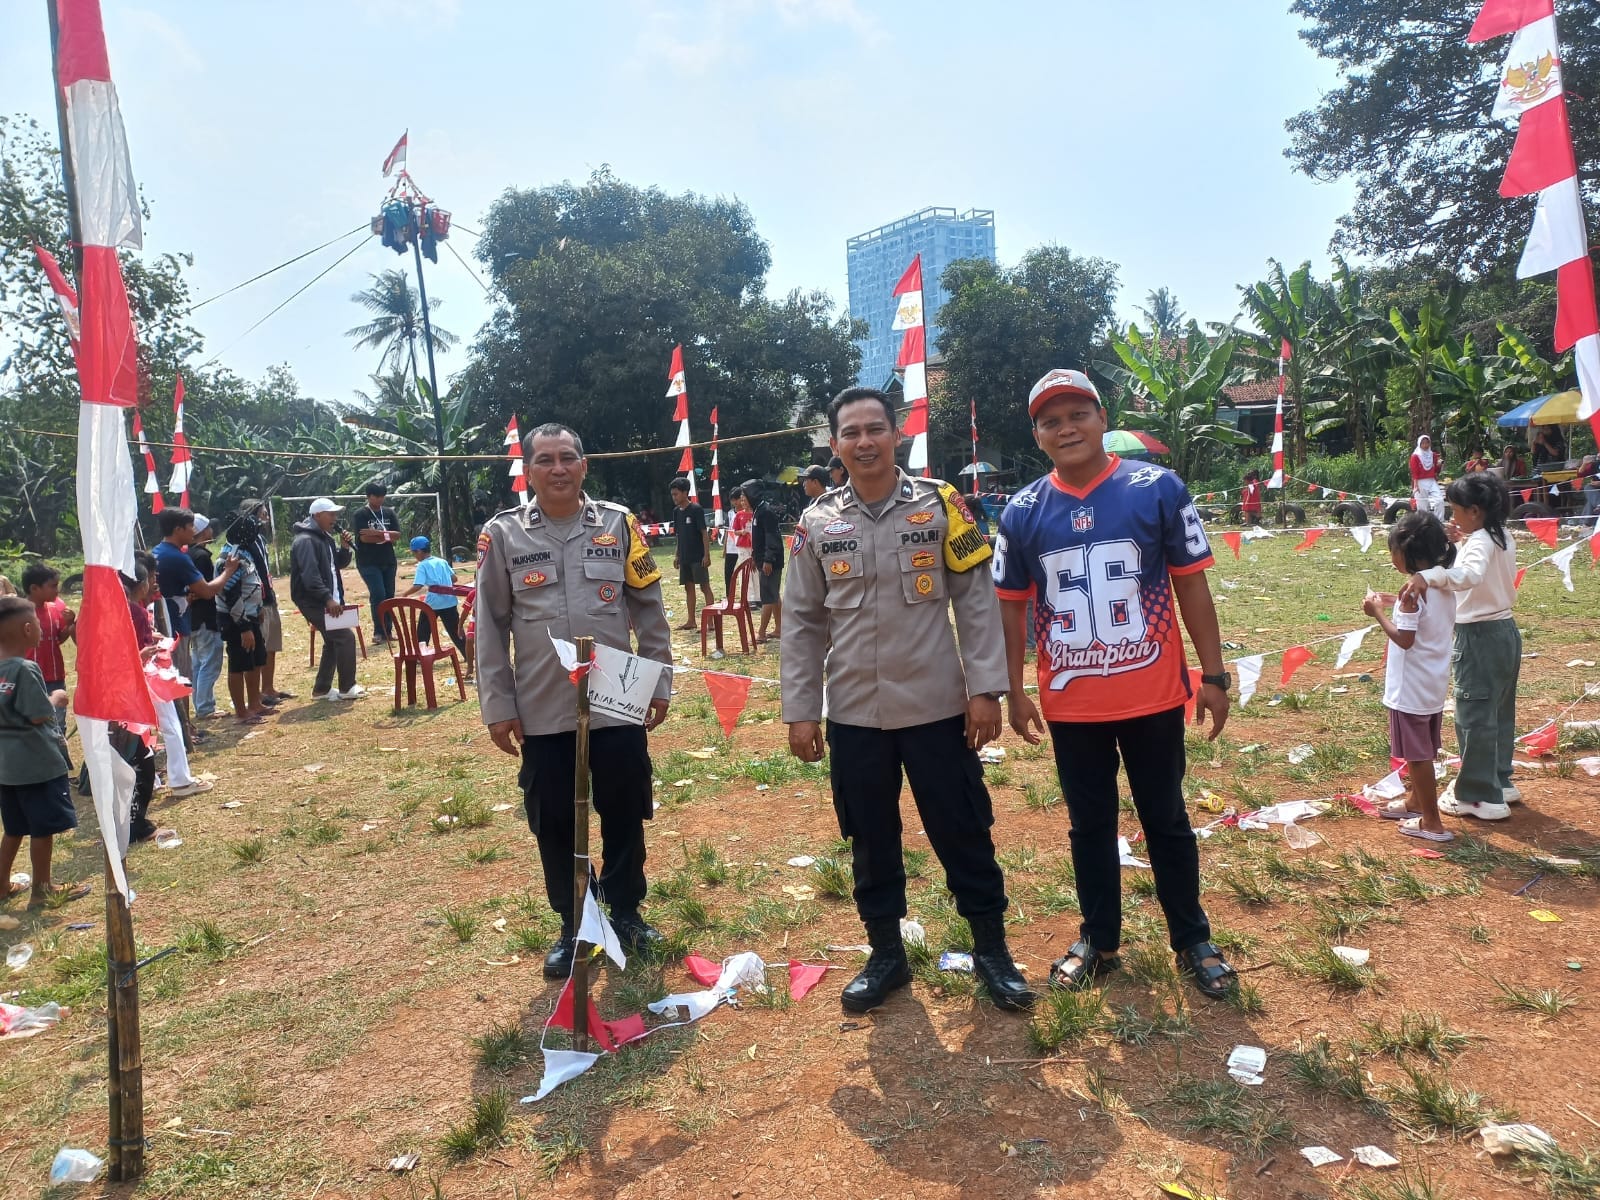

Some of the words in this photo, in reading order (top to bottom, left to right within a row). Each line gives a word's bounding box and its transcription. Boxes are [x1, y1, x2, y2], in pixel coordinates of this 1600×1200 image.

[901, 530, 939, 545] POLRI
[586, 548, 621, 558] POLRI
[821, 540, 857, 554] DIEKO
[1039, 538, 1147, 650] 56
[1045, 637, 1160, 677] Champion
